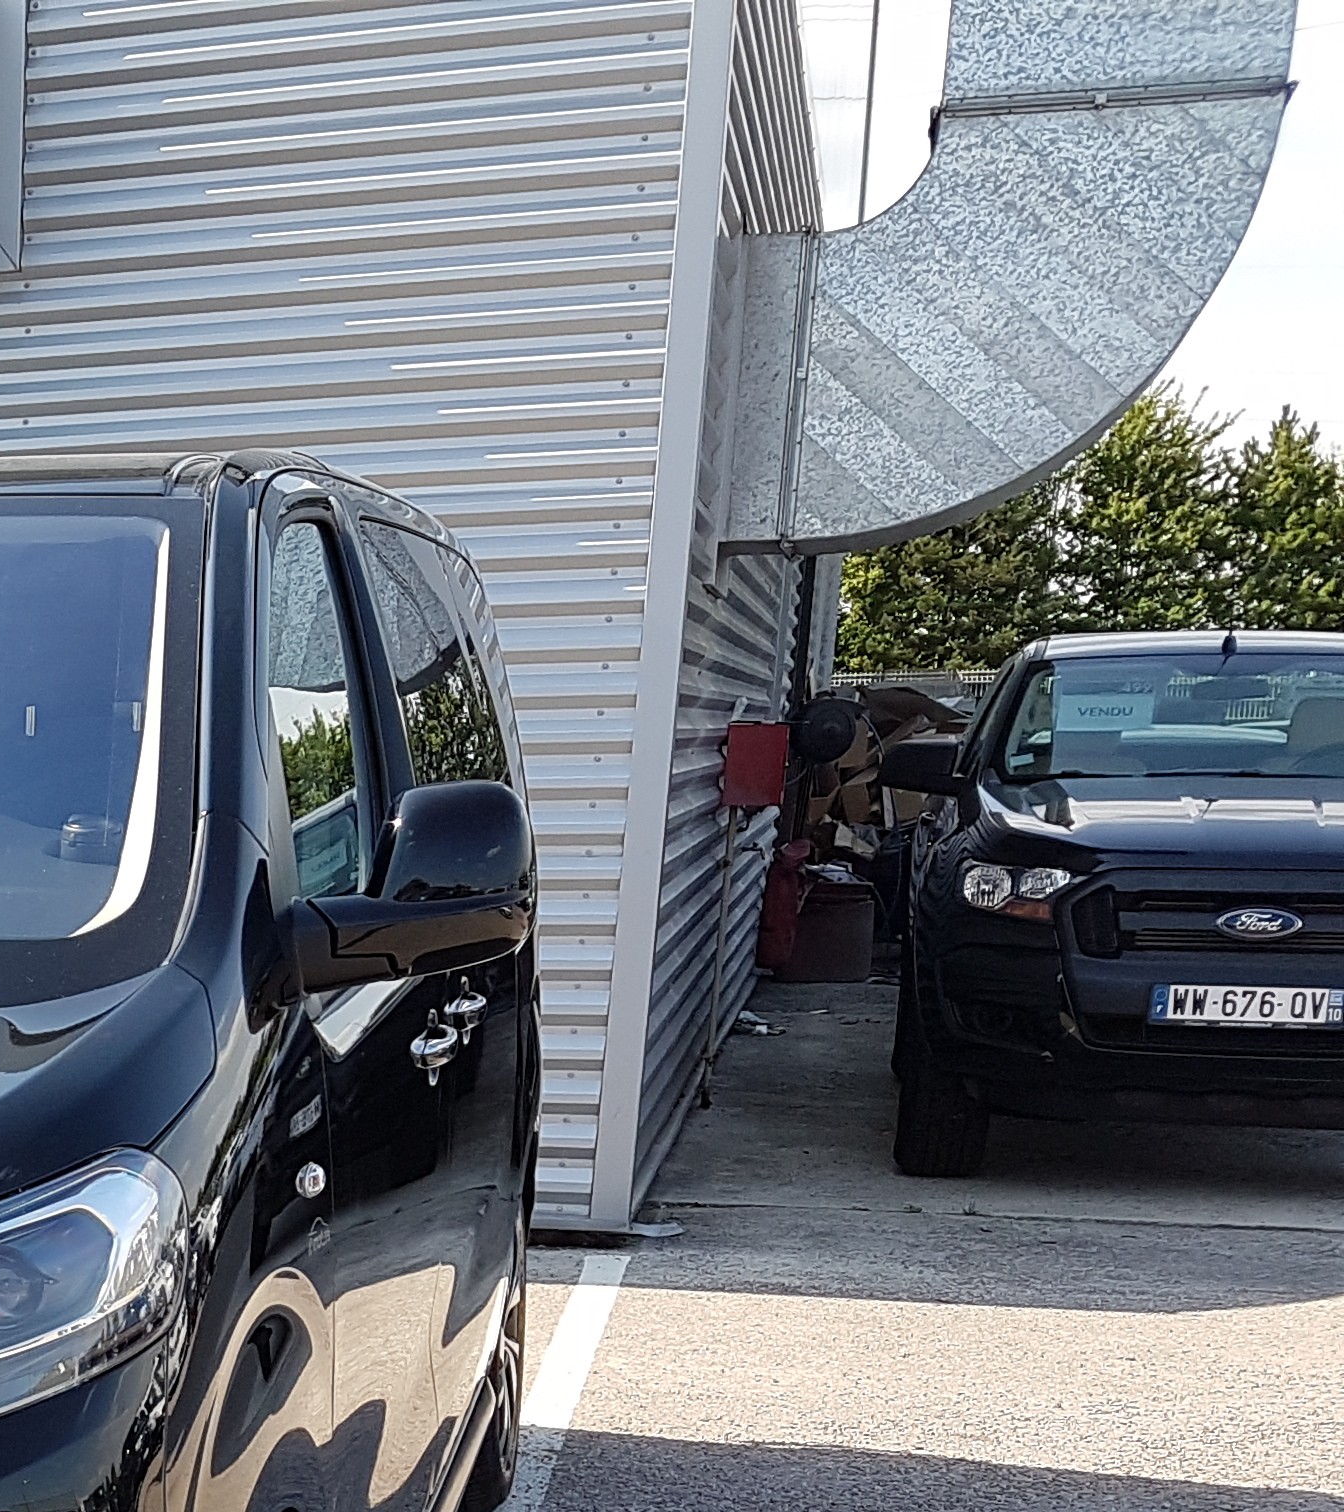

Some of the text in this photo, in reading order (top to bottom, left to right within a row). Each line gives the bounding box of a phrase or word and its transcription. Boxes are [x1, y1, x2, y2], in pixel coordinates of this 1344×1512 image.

[1077, 706, 1134, 717] VENDU
[1235, 912, 1284, 931] Ford
[1328, 1008, 1342, 1021] 10
